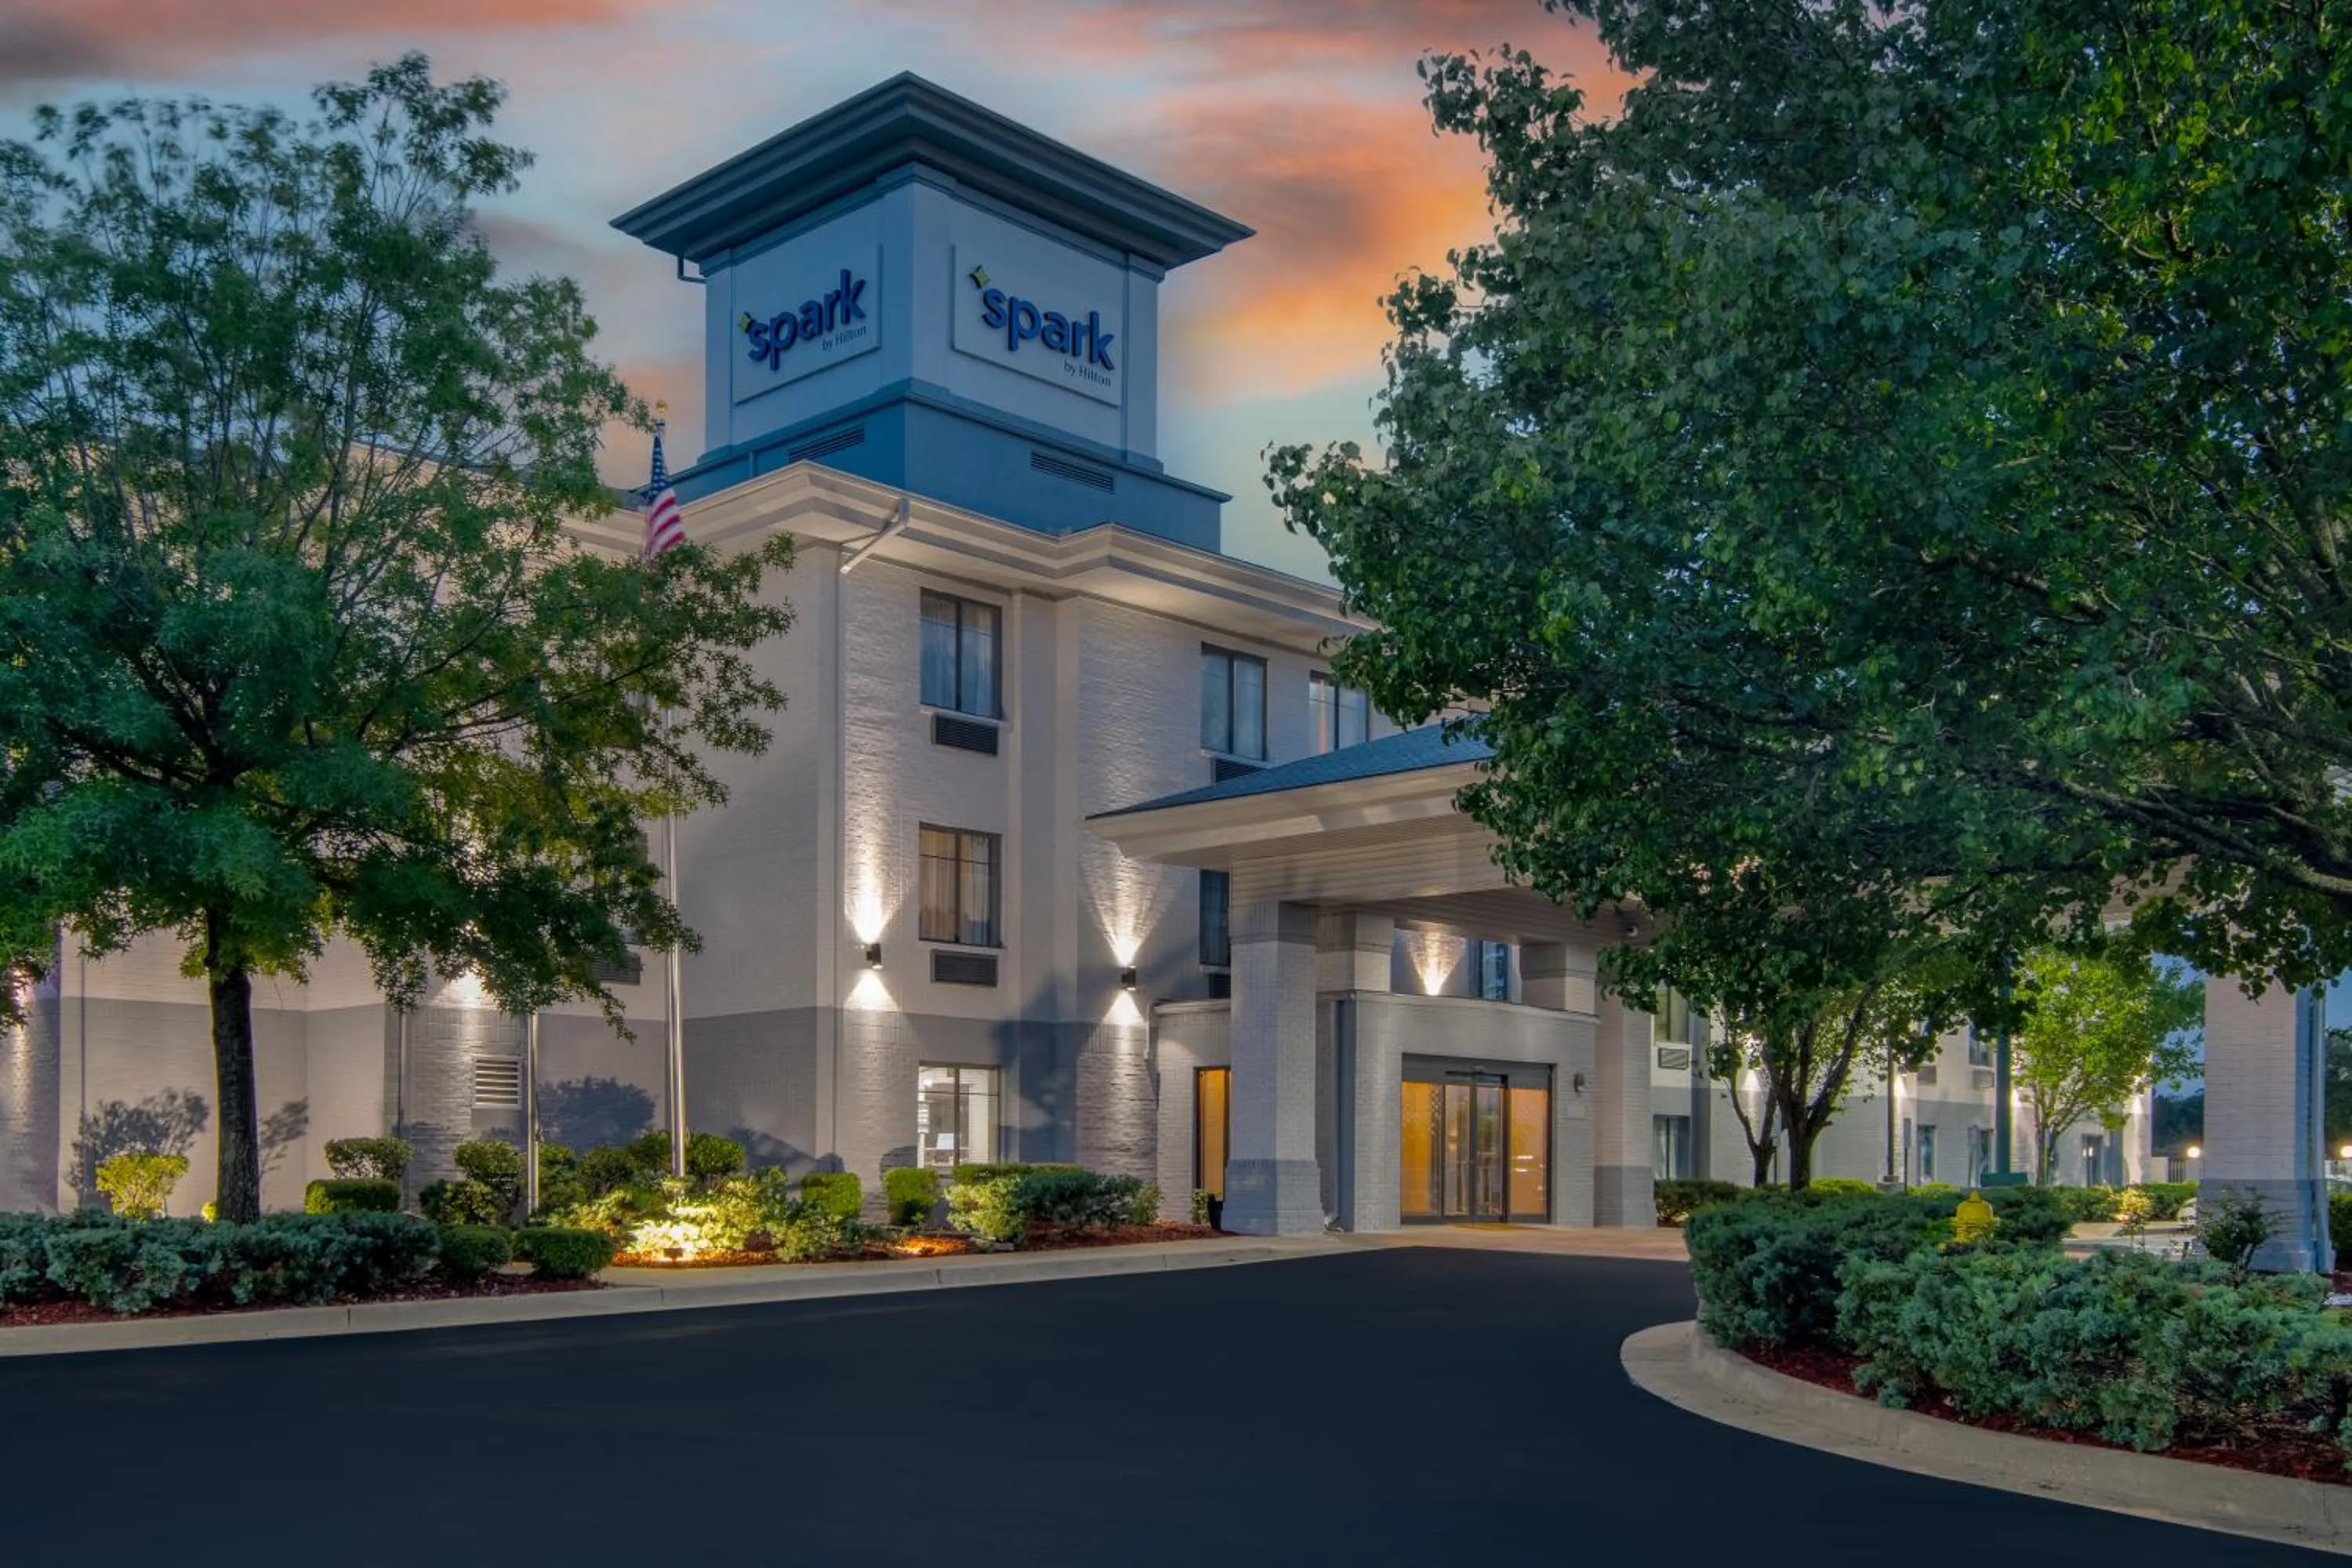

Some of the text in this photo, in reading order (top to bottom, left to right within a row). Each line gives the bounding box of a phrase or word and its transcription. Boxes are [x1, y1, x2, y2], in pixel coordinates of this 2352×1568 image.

[747, 268, 866, 371] spark
[822, 325, 866, 352] by Hilton
[982, 288, 1115, 370] spark
[1064, 359, 1112, 388] by Hilton
